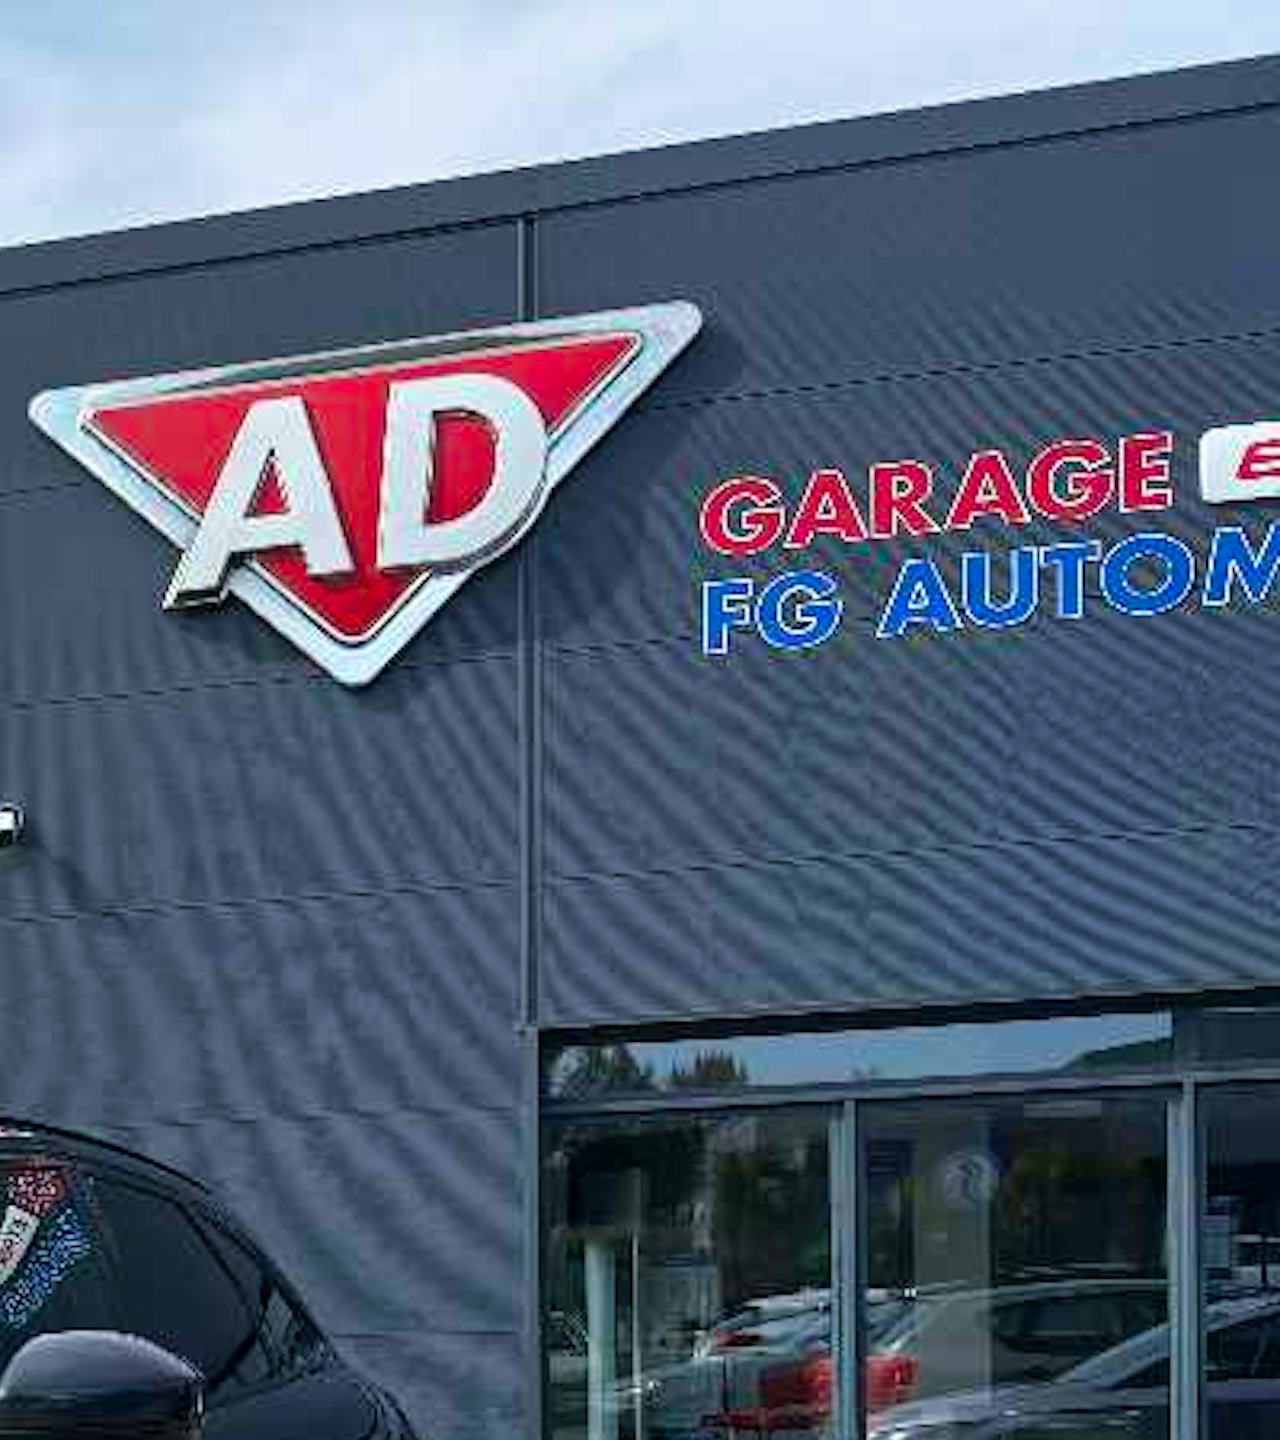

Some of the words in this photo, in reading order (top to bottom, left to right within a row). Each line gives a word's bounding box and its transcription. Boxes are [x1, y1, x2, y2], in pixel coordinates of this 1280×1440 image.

[162, 373, 548, 611] AD
[699, 431, 1174, 556] GARAGE
[702, 569, 842, 655] FG
